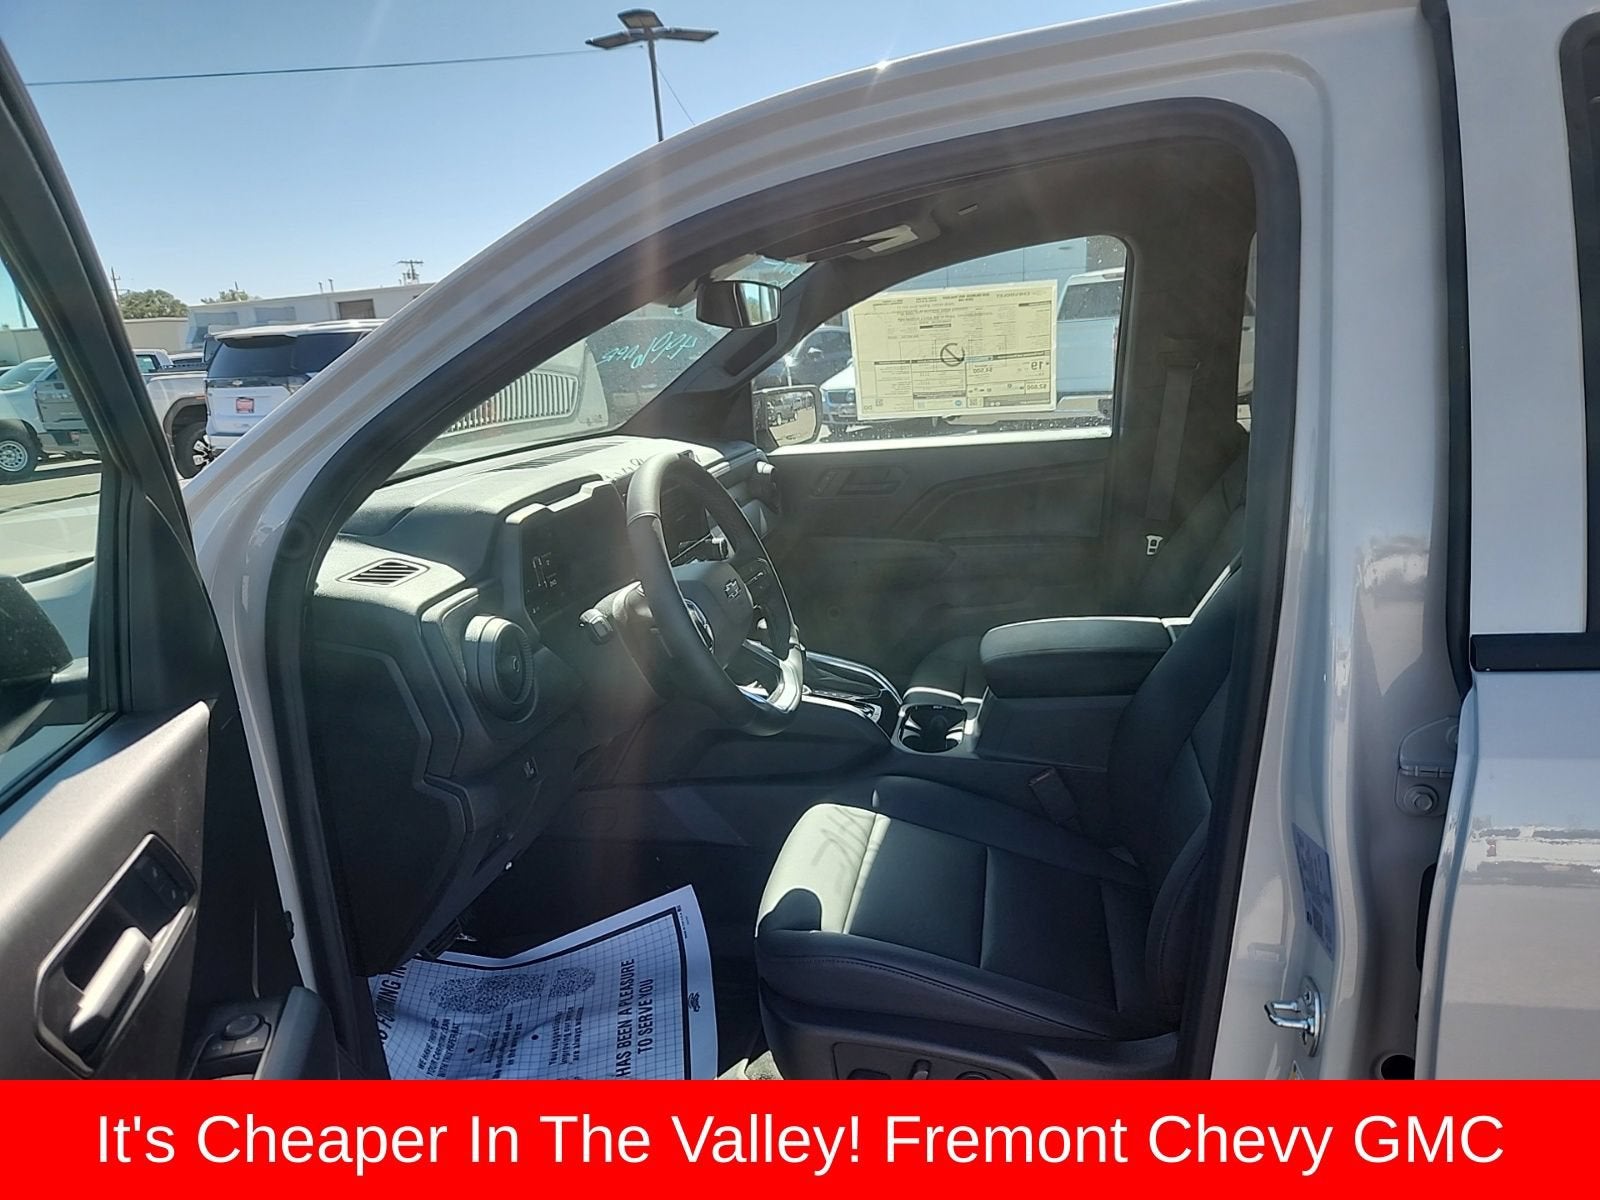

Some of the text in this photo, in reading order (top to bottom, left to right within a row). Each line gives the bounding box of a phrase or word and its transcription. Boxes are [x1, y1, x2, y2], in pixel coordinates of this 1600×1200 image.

[619, 959, 635, 1006] PLEASURE
[638, 979, 653, 1055] TO SERVE YOU
[617, 1019, 632, 1049] BEEN
[548, 1050, 558, 1066] Your
[616, 1051, 631, 1077] HAS
